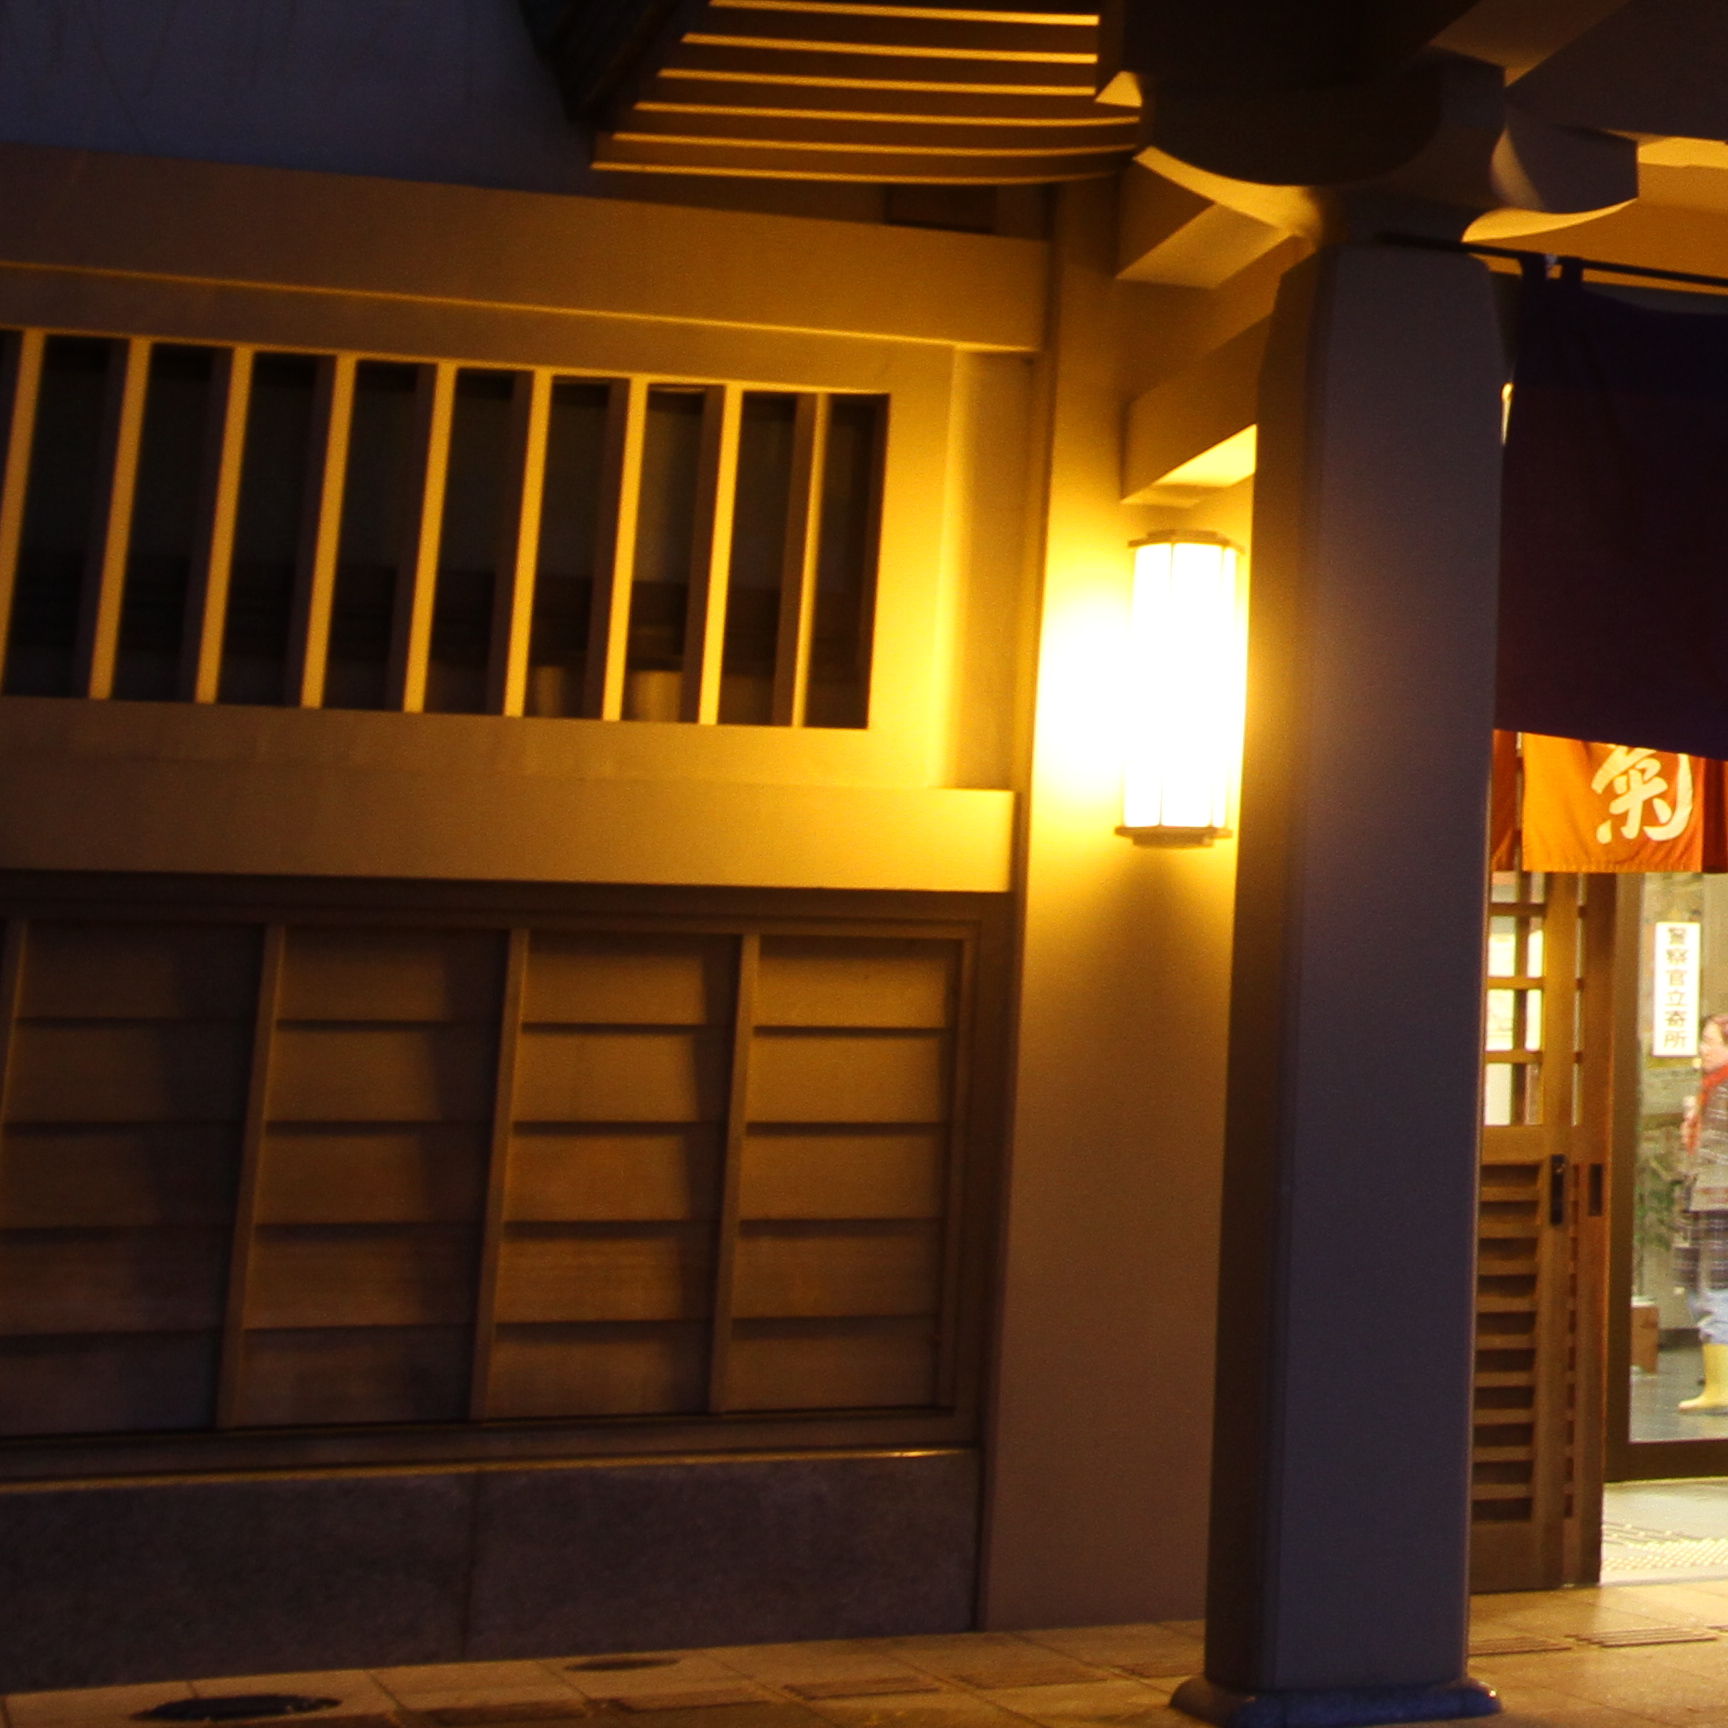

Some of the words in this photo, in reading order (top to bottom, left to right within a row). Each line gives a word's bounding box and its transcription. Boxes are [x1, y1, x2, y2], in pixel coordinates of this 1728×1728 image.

[1663, 926, 1689, 1049] 警察官立寄所
